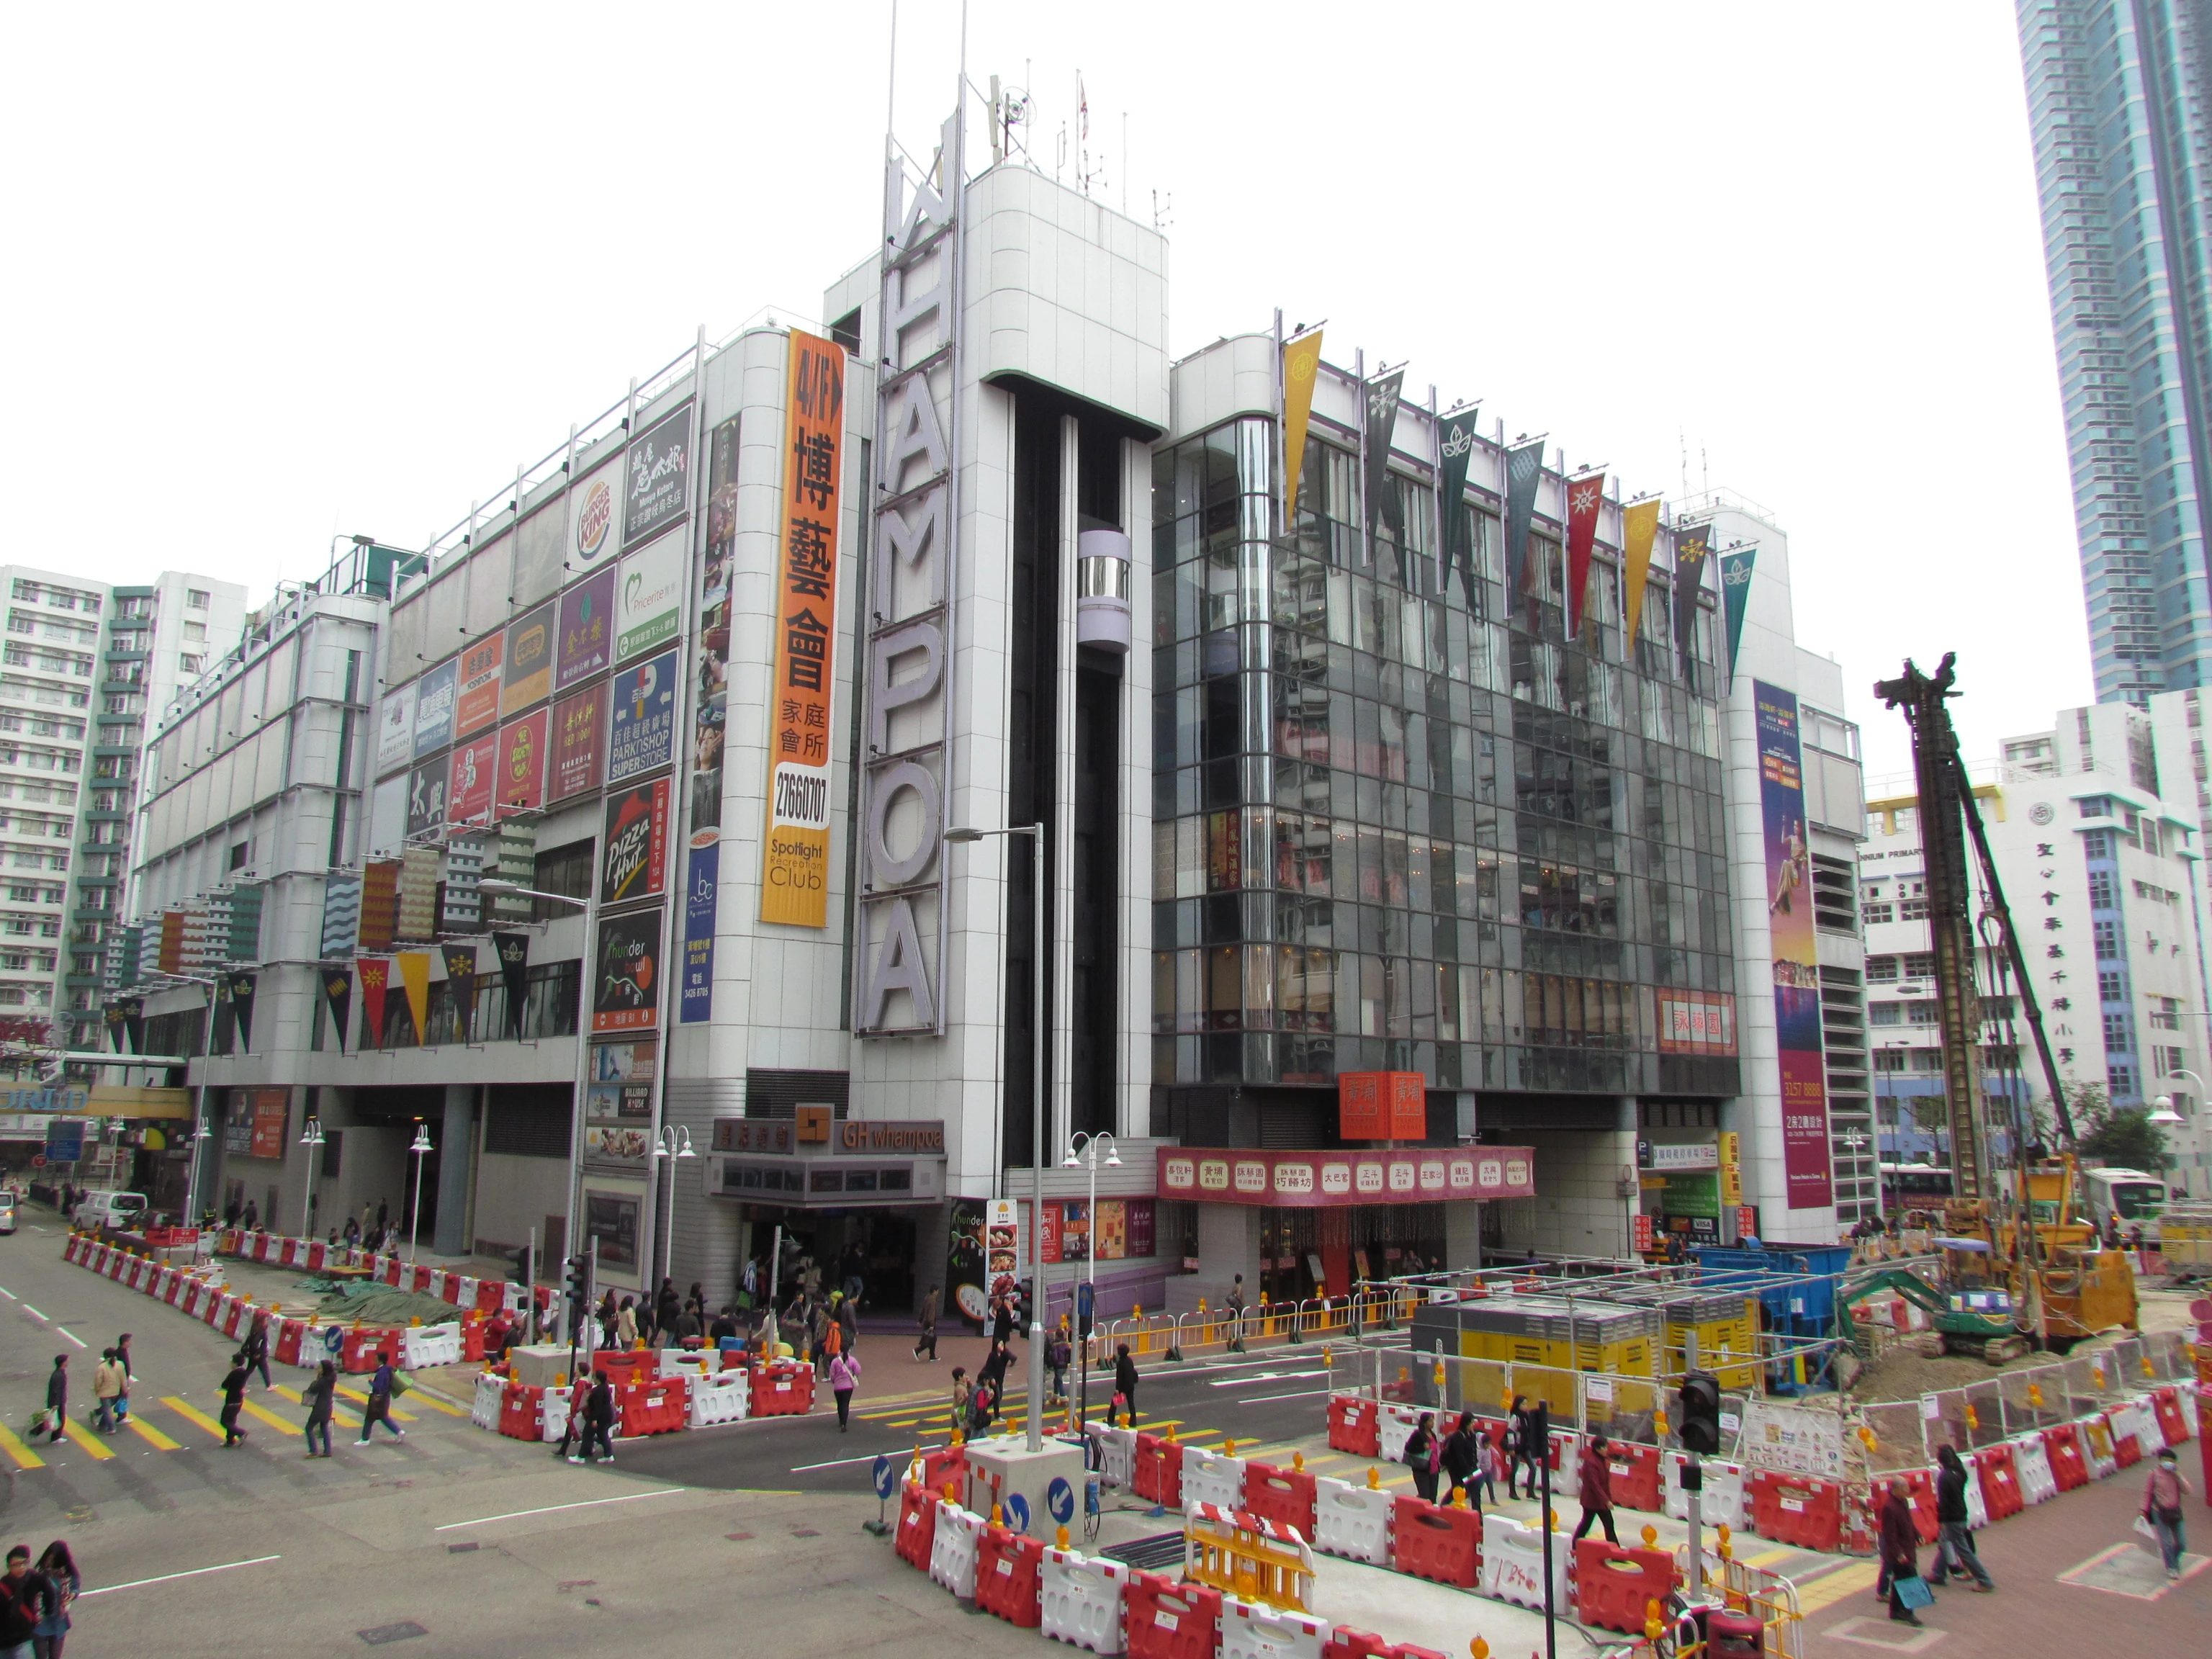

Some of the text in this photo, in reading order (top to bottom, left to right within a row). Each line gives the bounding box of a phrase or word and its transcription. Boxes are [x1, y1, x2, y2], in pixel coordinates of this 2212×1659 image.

[796, 349, 830, 421] 4/F
[656, 480, 675, 498] Kotaro
[580, 483, 610, 529] BURGER
[580, 503, 611, 547] KING
[786, 426, 835, 693] 博藝會
[633, 588, 665, 613] Pricerite
[781, 698, 826, 729] 家庭
[614, 710, 670, 746] 百佳超級廣場
[779, 727, 826, 759] 會所
[611, 746, 668, 778] SUPERSTORE
[775, 770, 827, 822] 27660707
[606, 817, 650, 884] Pizza
[771, 838, 823, 861] Spotlight
[613, 842, 646, 891] Hut
[769, 855, 823, 871] Recreation
[769, 866, 822, 891] Club
[607, 939, 646, 960] Thunder
[624, 956, 646, 974] bowl
[691, 973, 703, 985] 電話
[684, 987, 697, 999] 3426
[625, 1087, 648, 1098] BILLIARD
[1784, 1082, 1802, 1097] 3157
[843, 1122, 943, 1151] GH whampoa
[1638, 1141, 1647, 1152] P
[1168, 1165, 1192, 1175] 喜悅軒
[1204, 1166, 1224, 1177] 黃埔
[1421, 1170, 1443, 1180] 王家沙
[1205, 1177, 1223, 1185] 美食坊
[953, 1213, 985, 1226] Thunder
[1695, 1220, 1712, 1229] VISA
[968, 1227, 986, 1237] bowl
